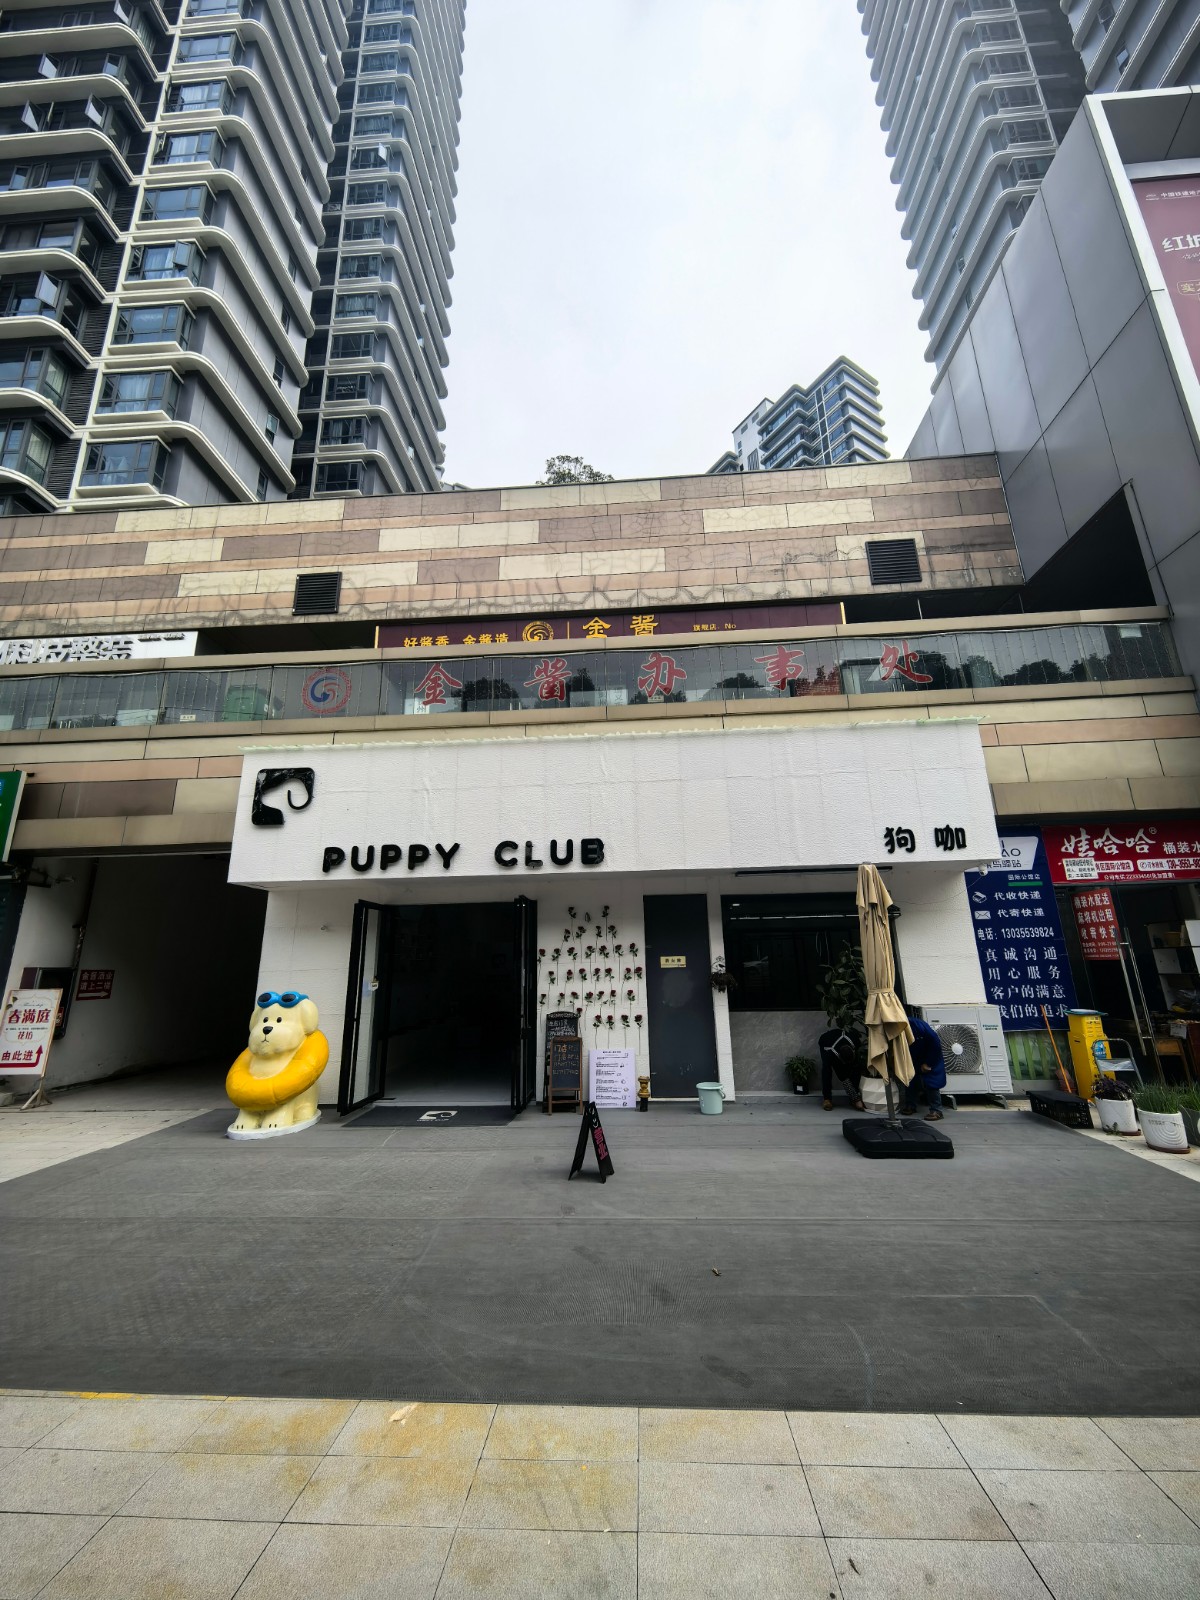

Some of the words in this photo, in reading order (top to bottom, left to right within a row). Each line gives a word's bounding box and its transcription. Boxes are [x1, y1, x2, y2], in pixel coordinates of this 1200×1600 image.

[883, 824, 967, 854] 狗咖
[1060, 828, 1156, 857] 娃哈哈
[322, 842, 461, 873] PUPPY
[494, 837, 605, 868] CLUB
[993, 891, 1042, 901] 代收快递
[997, 907, 1045, 918] 代寄快递
[984, 946, 1058, 962] 真诚沟通
[988, 964, 1061, 981] 用心服务
[991, 984, 1066, 1000] 客户的满意
[1, 1050, 33, 1061] 由此进
